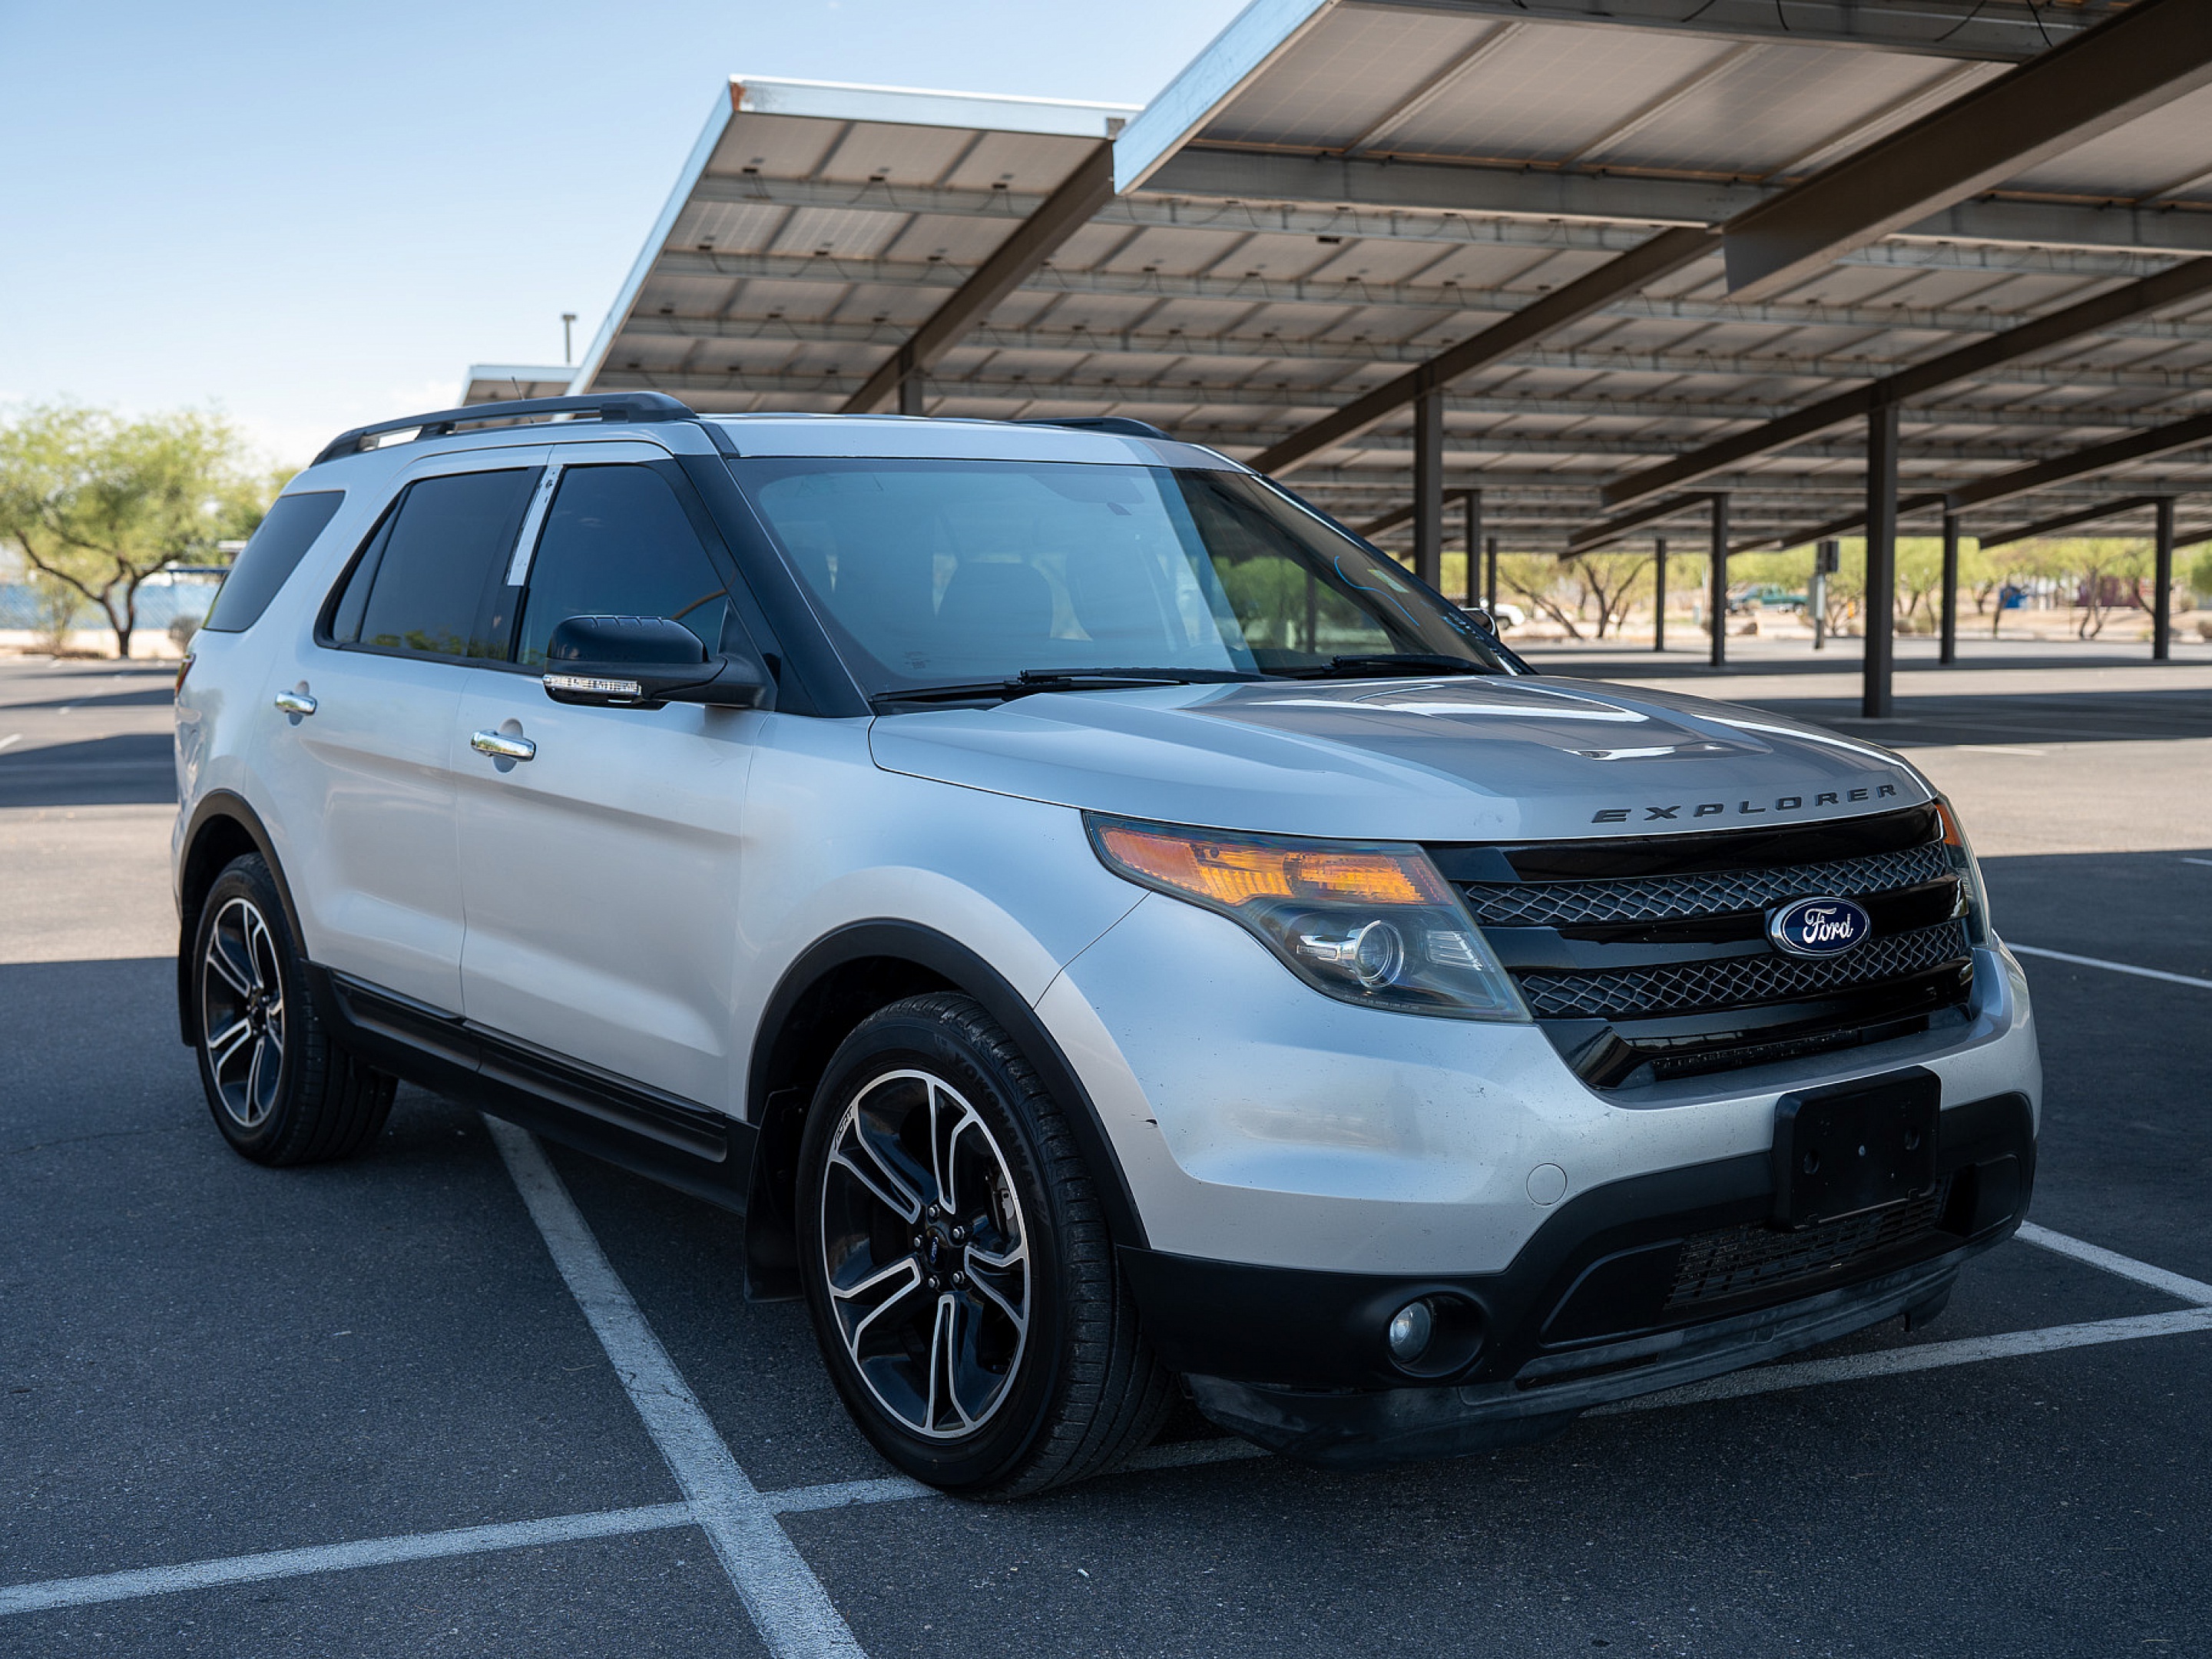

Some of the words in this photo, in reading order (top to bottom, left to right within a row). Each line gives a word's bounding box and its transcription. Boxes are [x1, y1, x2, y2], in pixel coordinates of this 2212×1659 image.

[1591, 784, 1896, 823] EXPLORER
[1803, 907, 1854, 944] Ford
[953, 1051, 1036, 1187] YOKOHAMA
